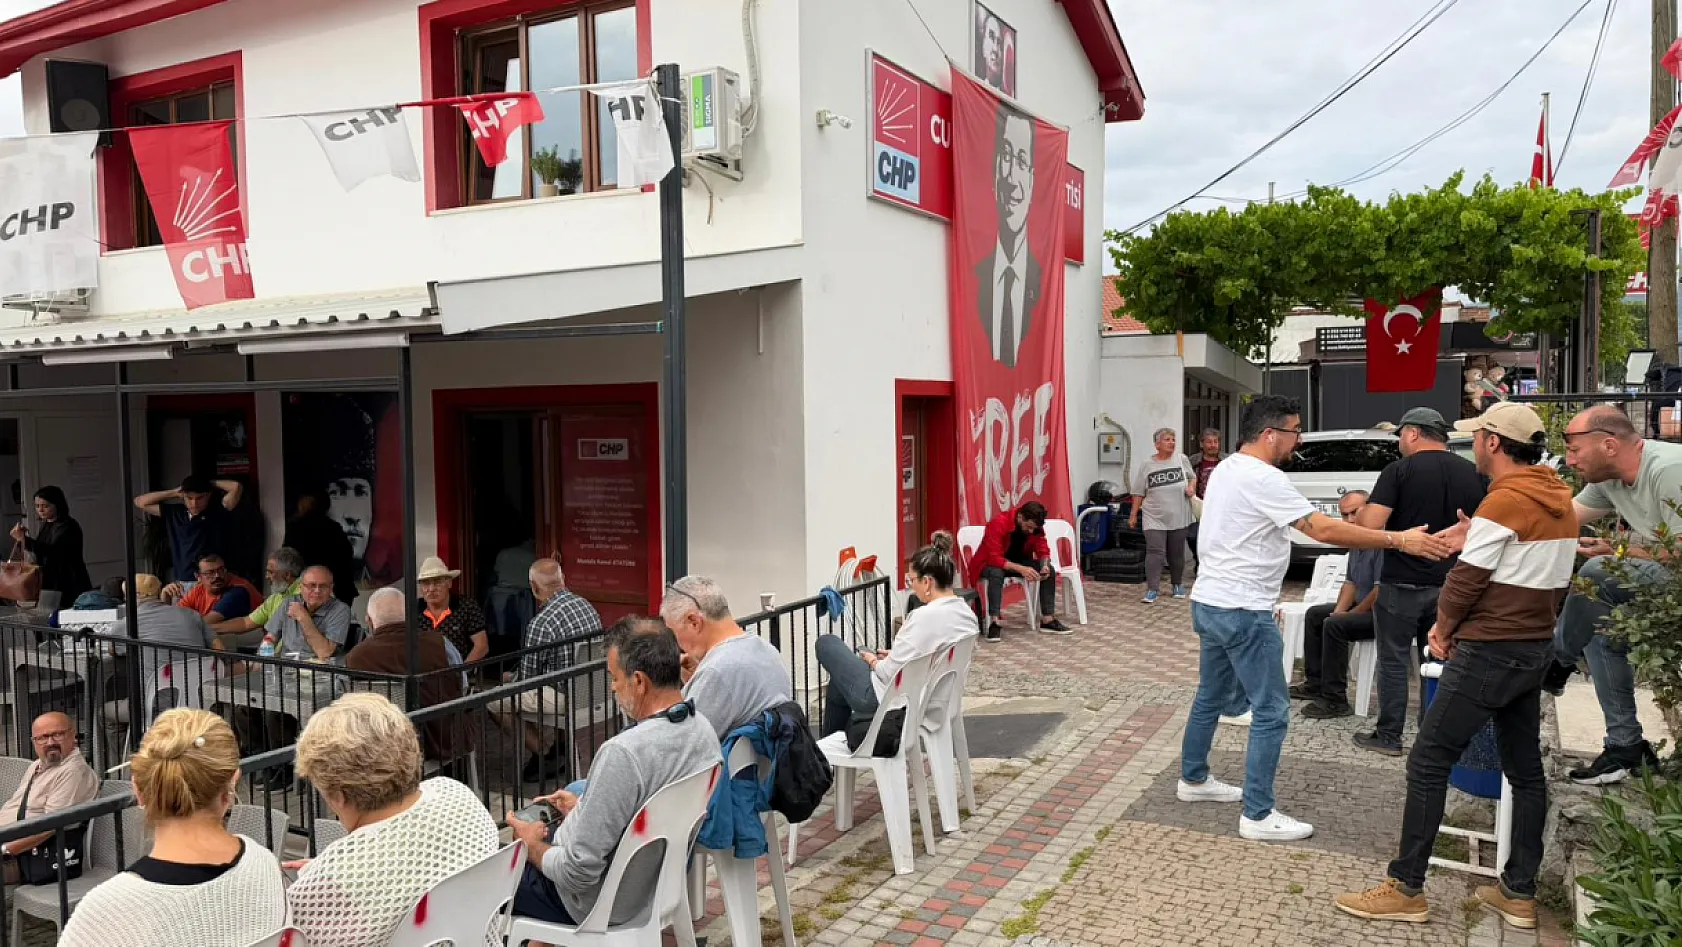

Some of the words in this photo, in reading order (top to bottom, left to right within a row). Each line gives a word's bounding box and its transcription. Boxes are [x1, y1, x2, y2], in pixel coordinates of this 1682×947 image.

[878, 151, 916, 191] CHP
[0, 202, 75, 241] CHP
[599, 442, 624, 455] CHP
[1150, 470, 1184, 487] XBOX
